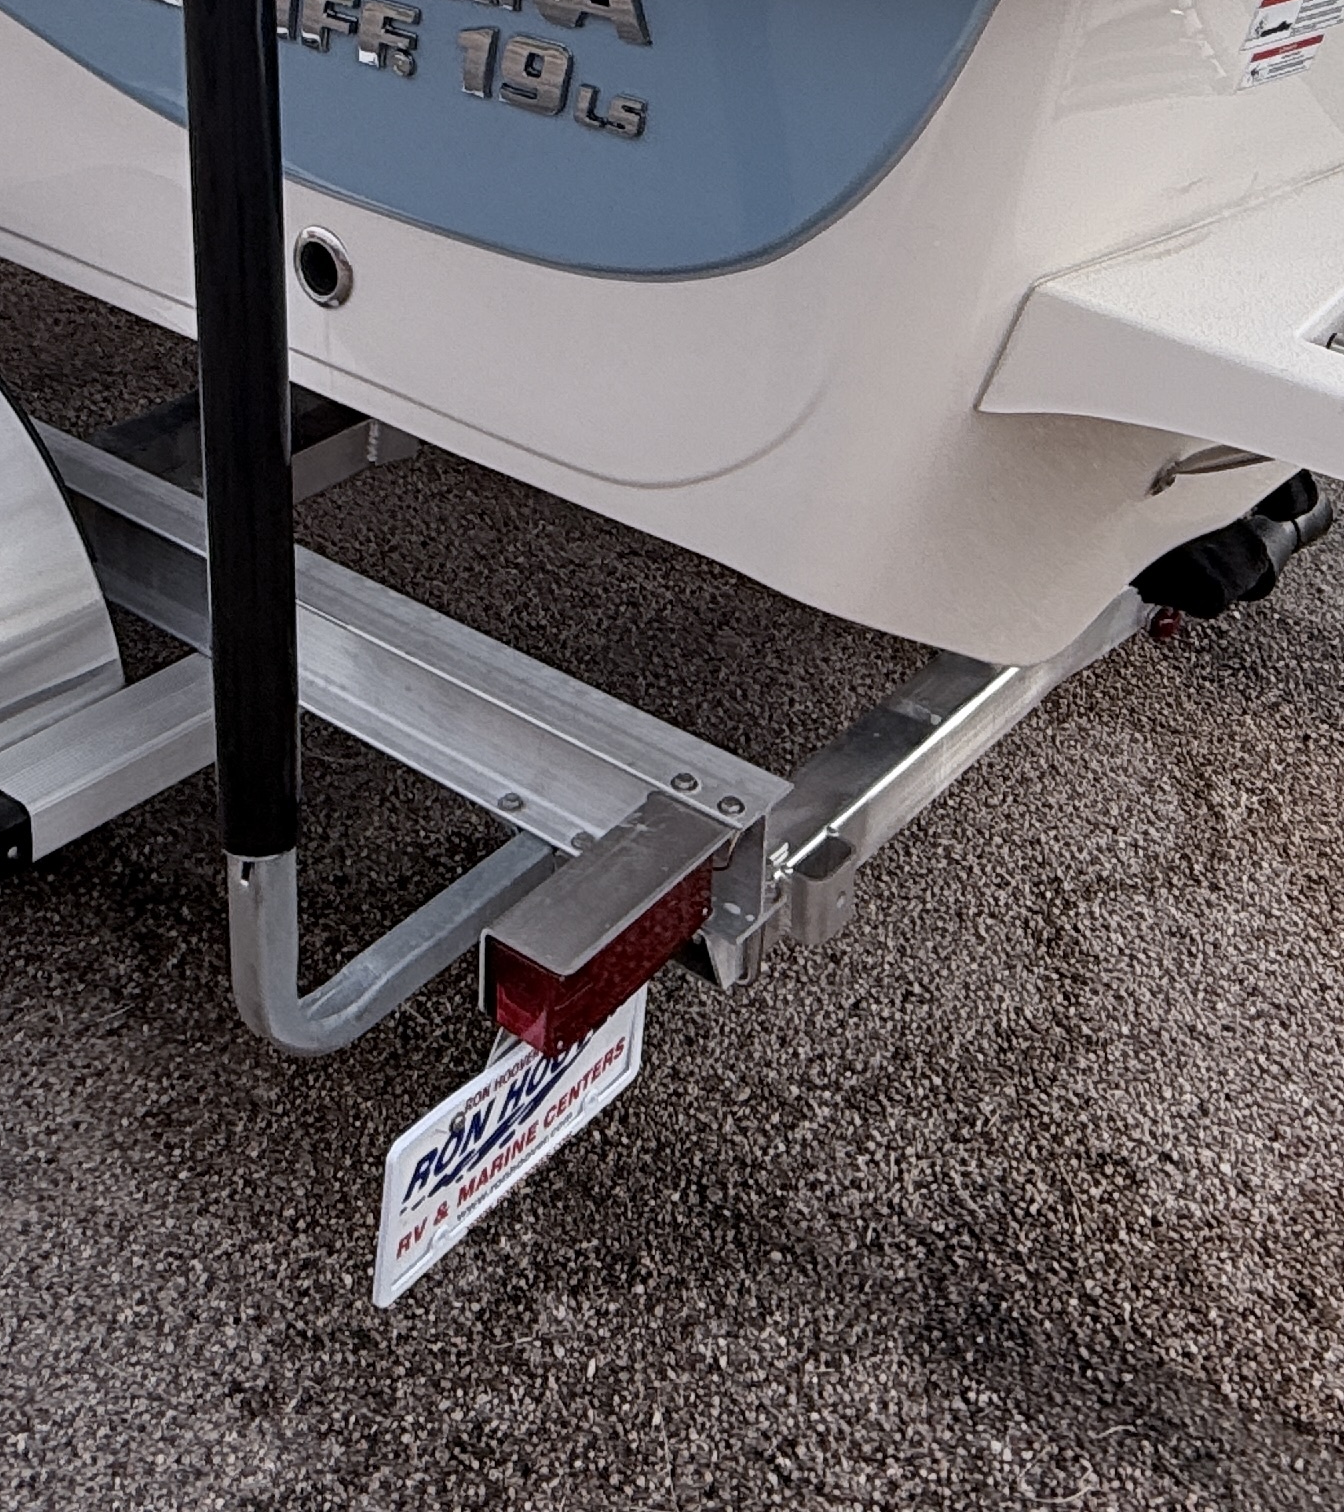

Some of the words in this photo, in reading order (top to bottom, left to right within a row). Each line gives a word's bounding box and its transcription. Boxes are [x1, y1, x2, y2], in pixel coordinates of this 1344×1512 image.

[396, 1216, 428, 1260] RV
[432, 1200, 450, 1227] &
[456, 1119, 540, 1208] MARINE
[542, 1036, 626, 1130] CENTERS
[401, 1096, 496, 1205] RON
